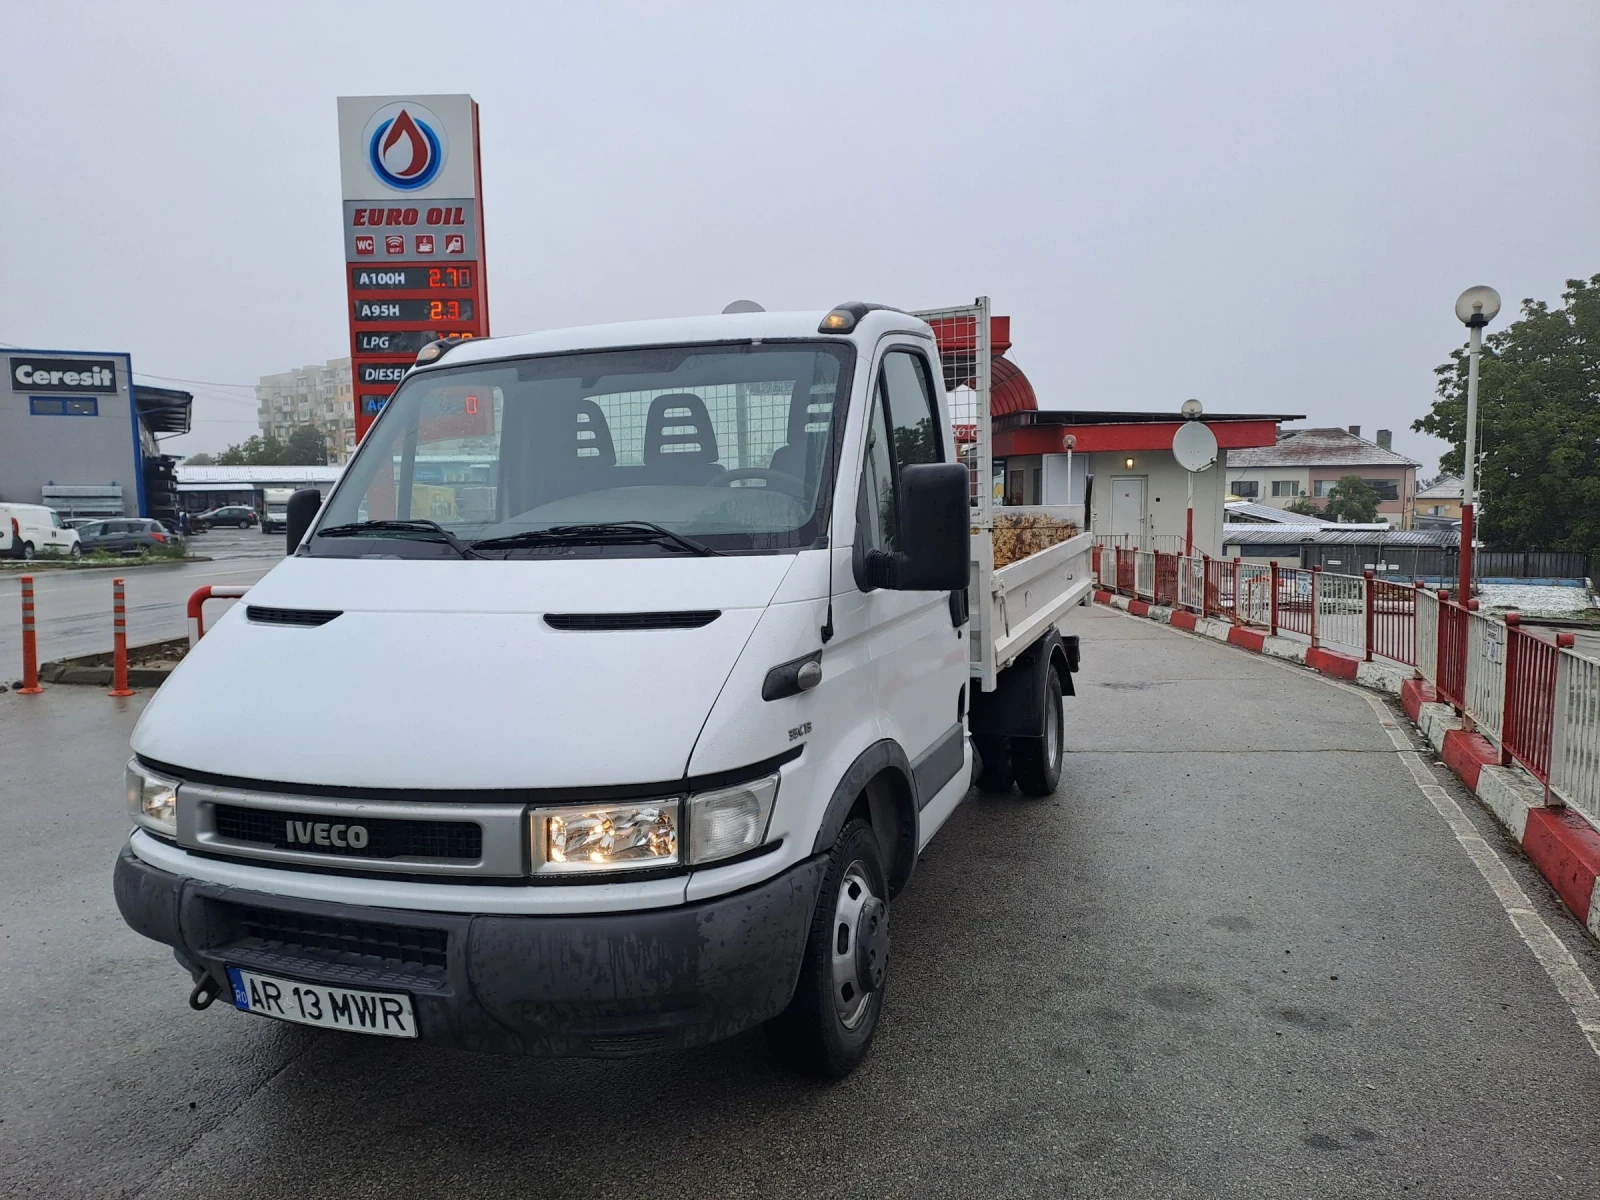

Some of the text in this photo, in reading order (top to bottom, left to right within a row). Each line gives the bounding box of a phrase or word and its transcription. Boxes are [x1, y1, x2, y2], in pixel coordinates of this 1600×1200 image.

[353, 207, 465, 227] EURO OIL
[357, 240, 373, 250] WC
[359, 272, 405, 285] A100H
[361, 304, 400, 317] A95H
[363, 337, 389, 348] LPG
[15, 365, 112, 386] Ceresit
[286, 820, 369, 849] IVECO
[235, 989, 247, 1004] RO
[250, 978, 406, 1031] AR 13 MWR
